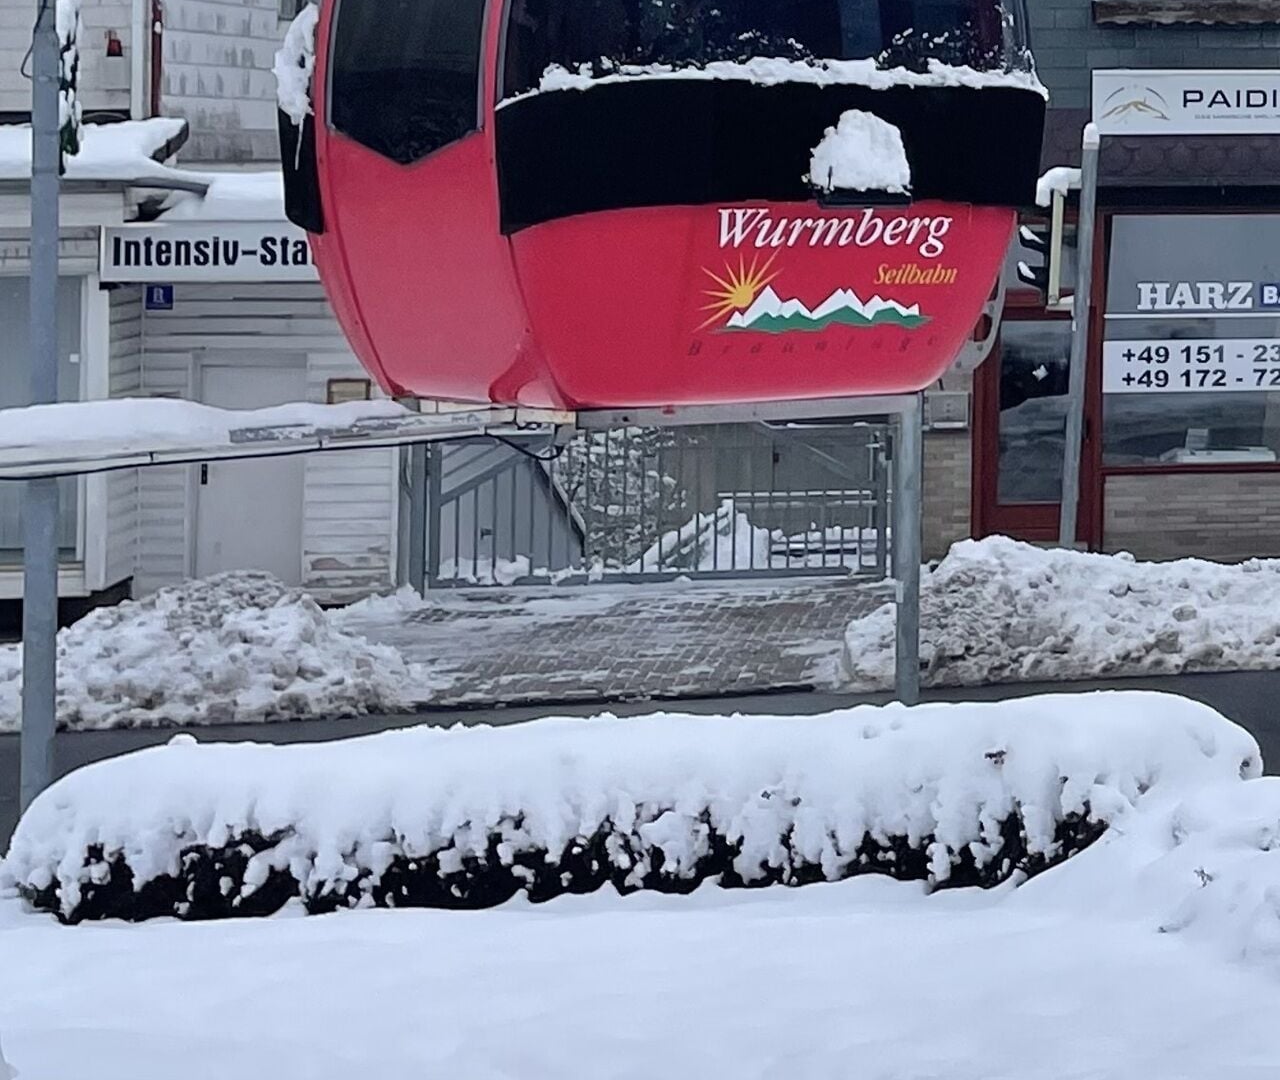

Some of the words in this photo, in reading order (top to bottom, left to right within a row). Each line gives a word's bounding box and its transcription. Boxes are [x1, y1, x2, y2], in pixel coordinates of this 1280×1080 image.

[717, 207, 954, 258] Wurmberg
[112, 236, 312, 267] Intensiv-Sta
[873, 263, 958, 286] Seilbahn
[1136, 281, 1254, 310] HARZ
[1121, 345, 1170, 364] +49
[1180, 345, 1225, 364] 151
[1121, 369, 1170, 388] +49
[1180, 369, 1227, 388] 172
